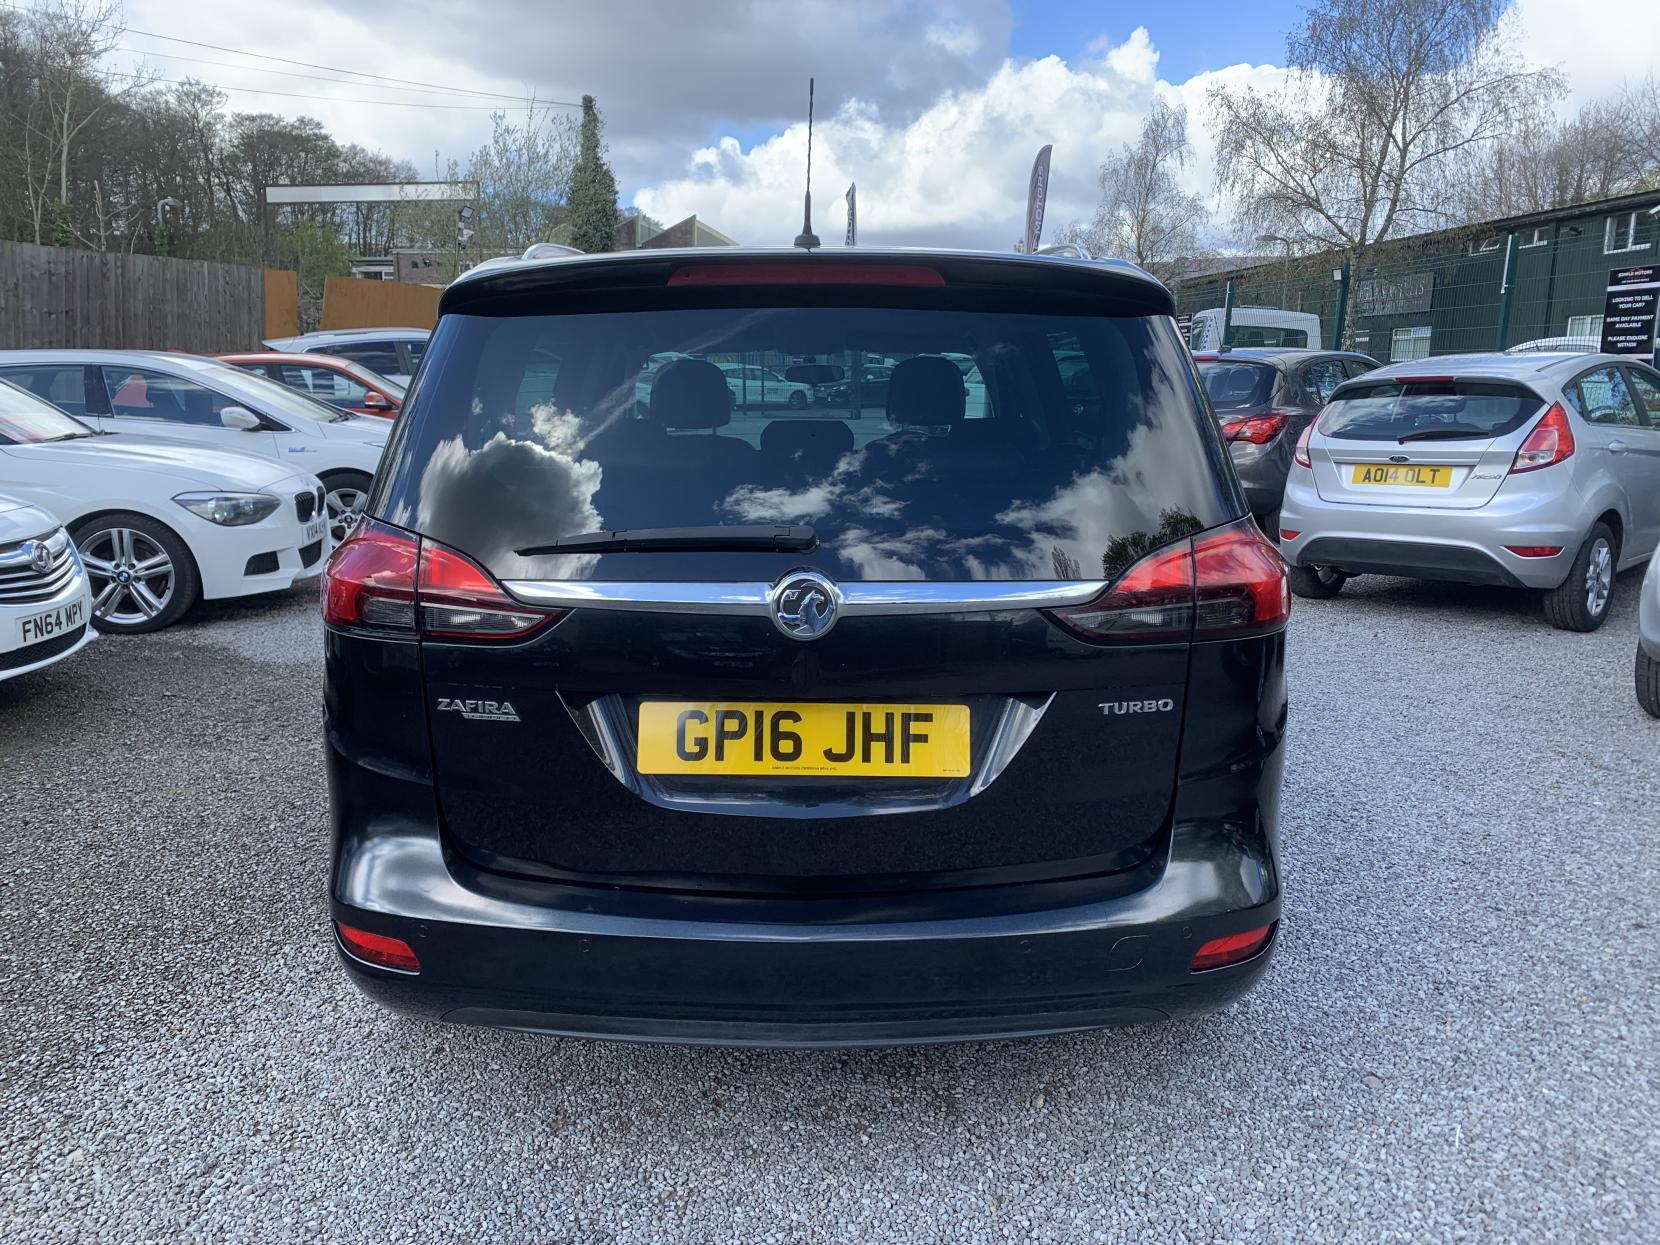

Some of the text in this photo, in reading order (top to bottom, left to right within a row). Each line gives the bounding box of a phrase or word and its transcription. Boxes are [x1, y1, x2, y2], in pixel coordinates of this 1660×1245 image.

[22, 600, 83, 643] FN64 MPY
[437, 698, 516, 714] ZAFIRA
[1098, 698, 1175, 715] TURBO
[676, 710, 934, 764] GP16 JHF
